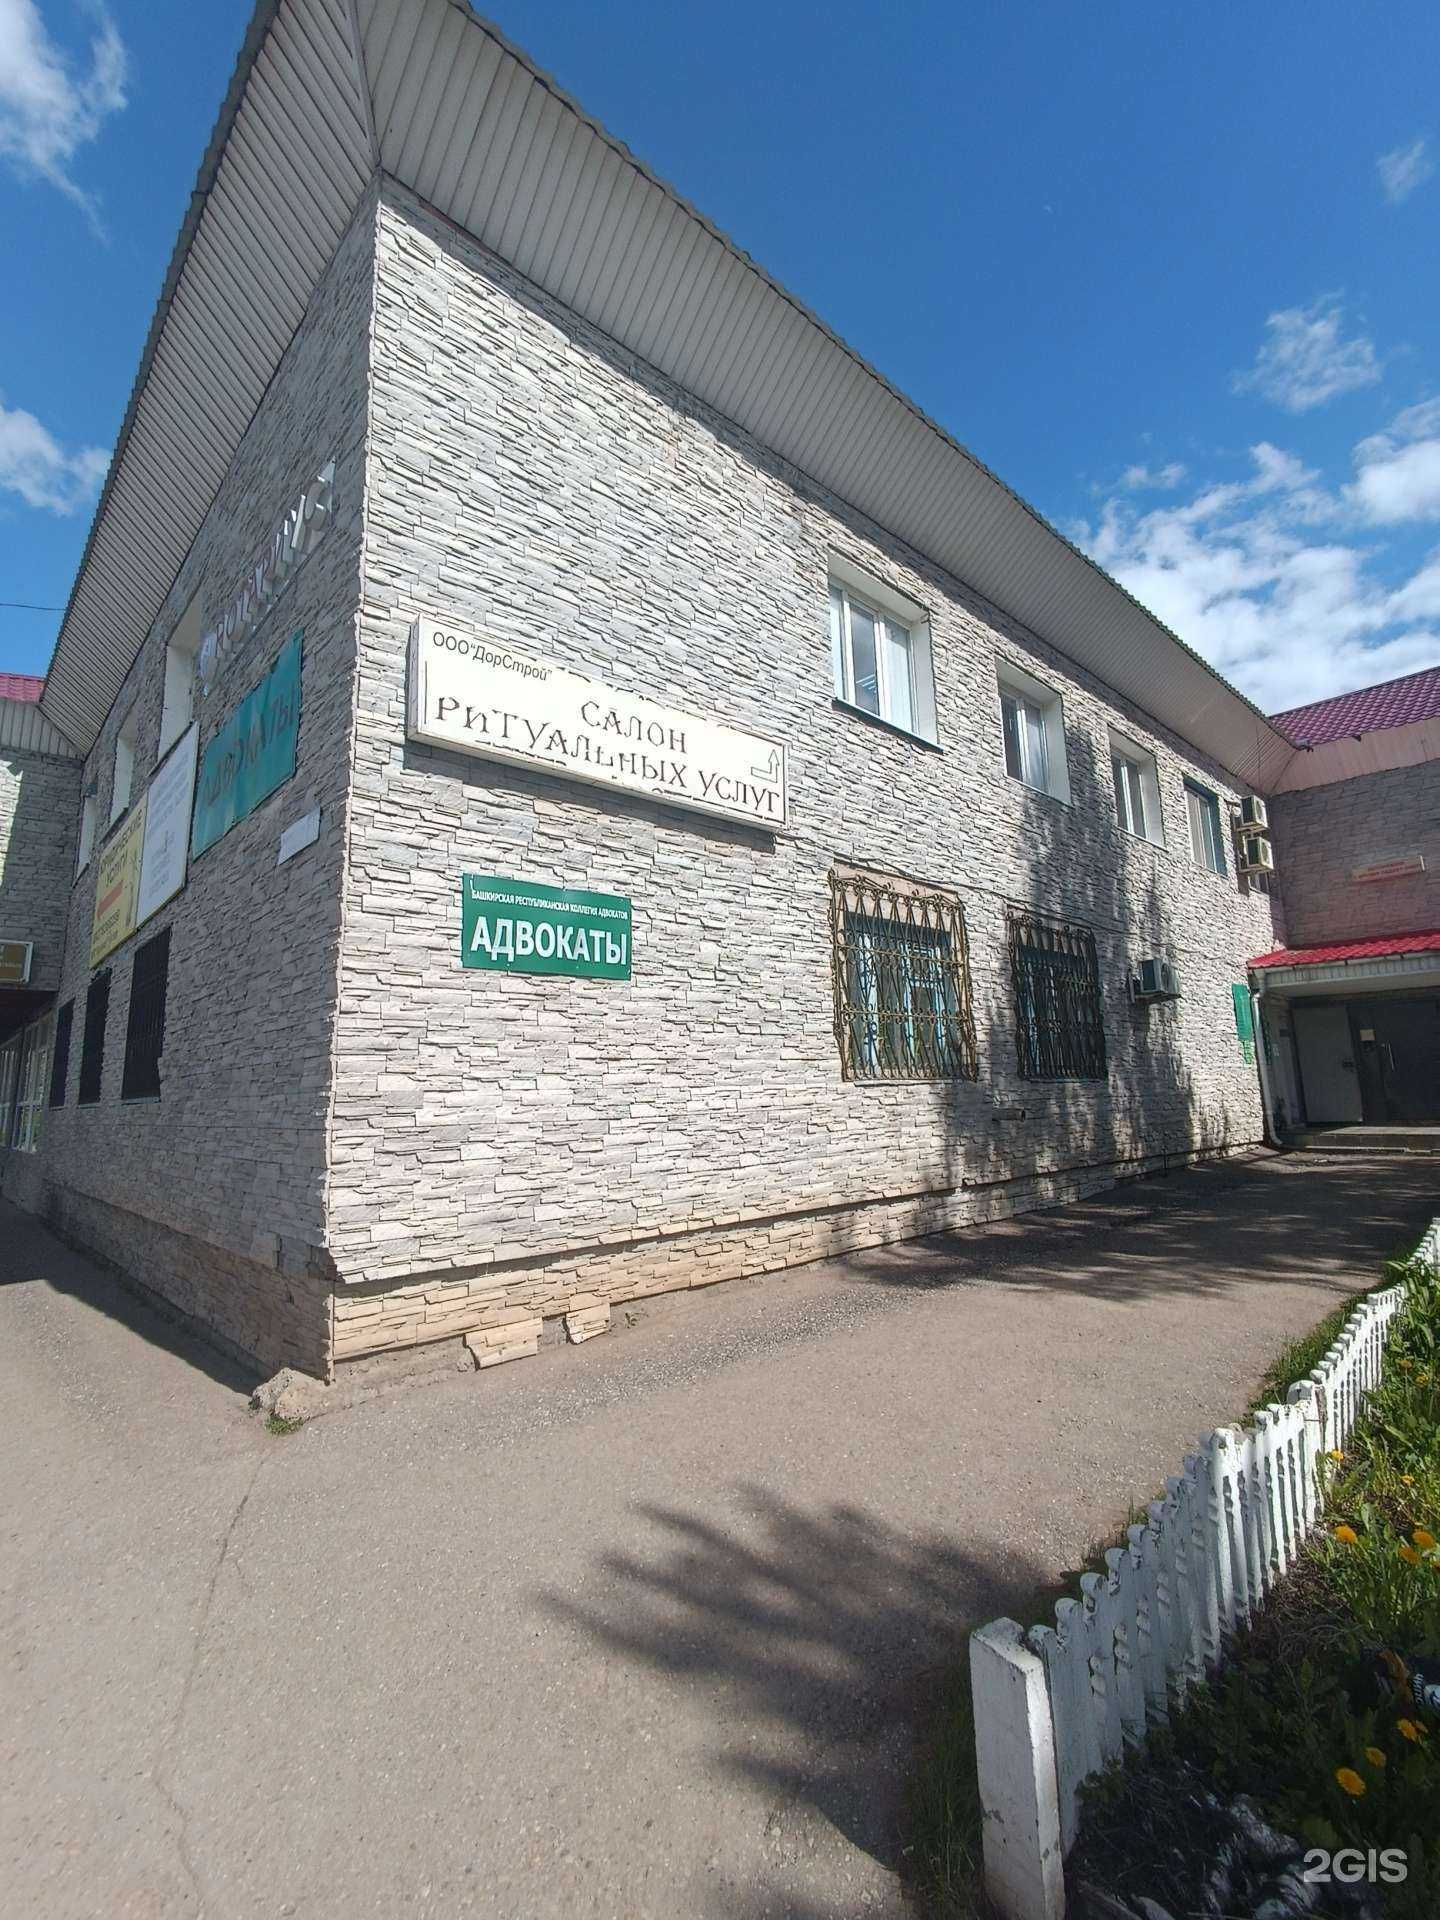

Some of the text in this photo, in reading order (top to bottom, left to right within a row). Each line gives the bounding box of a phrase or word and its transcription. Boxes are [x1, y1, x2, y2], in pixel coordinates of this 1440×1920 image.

[581, 700, 686, 755] САЛОН
[435, 696, 780, 813] РИТУАЛЬНЫХ УСЛУГ
[471, 889, 628, 920] БАШКИРСКАЯ РЕСПУБЛИКАНСКАЯ КОЛЛЕГИЯ АДВОКАТОВ
[470, 916, 627, 963] АДВОКАТЫ
